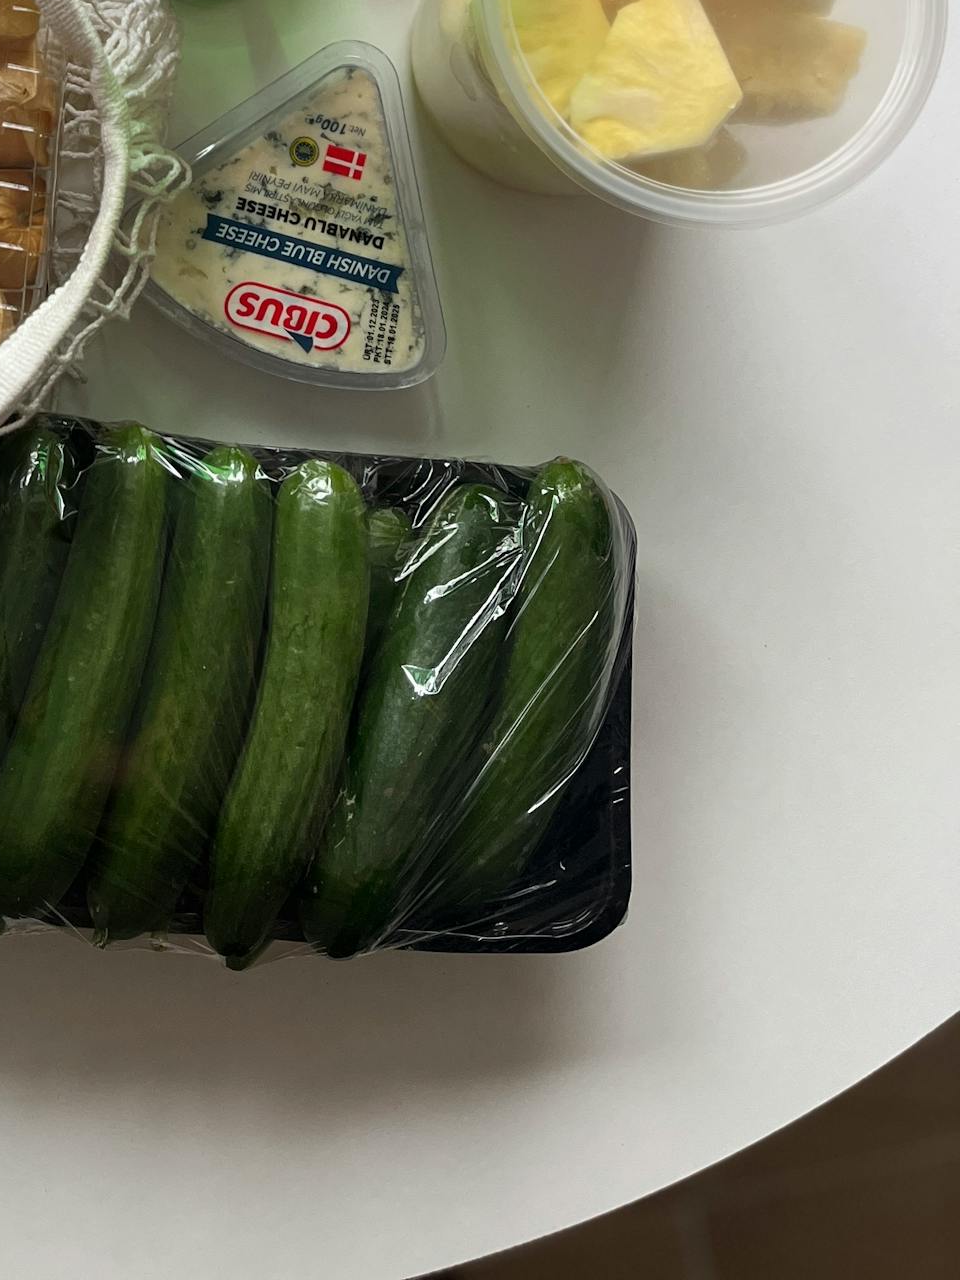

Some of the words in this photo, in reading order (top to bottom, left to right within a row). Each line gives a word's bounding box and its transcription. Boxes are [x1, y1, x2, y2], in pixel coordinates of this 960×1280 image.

[293, 183, 321, 198] MAVİ
[235, 197, 302, 225] CHEESE
[364, 216, 385, 229] TAM
[216, 223, 280, 251] CHEESE
[305, 217, 385, 250] DANABLU
[281, 241, 327, 266] BLUE
[327, 255, 392, 283] DANISH
[236, 292, 338, 340] CIBUS
